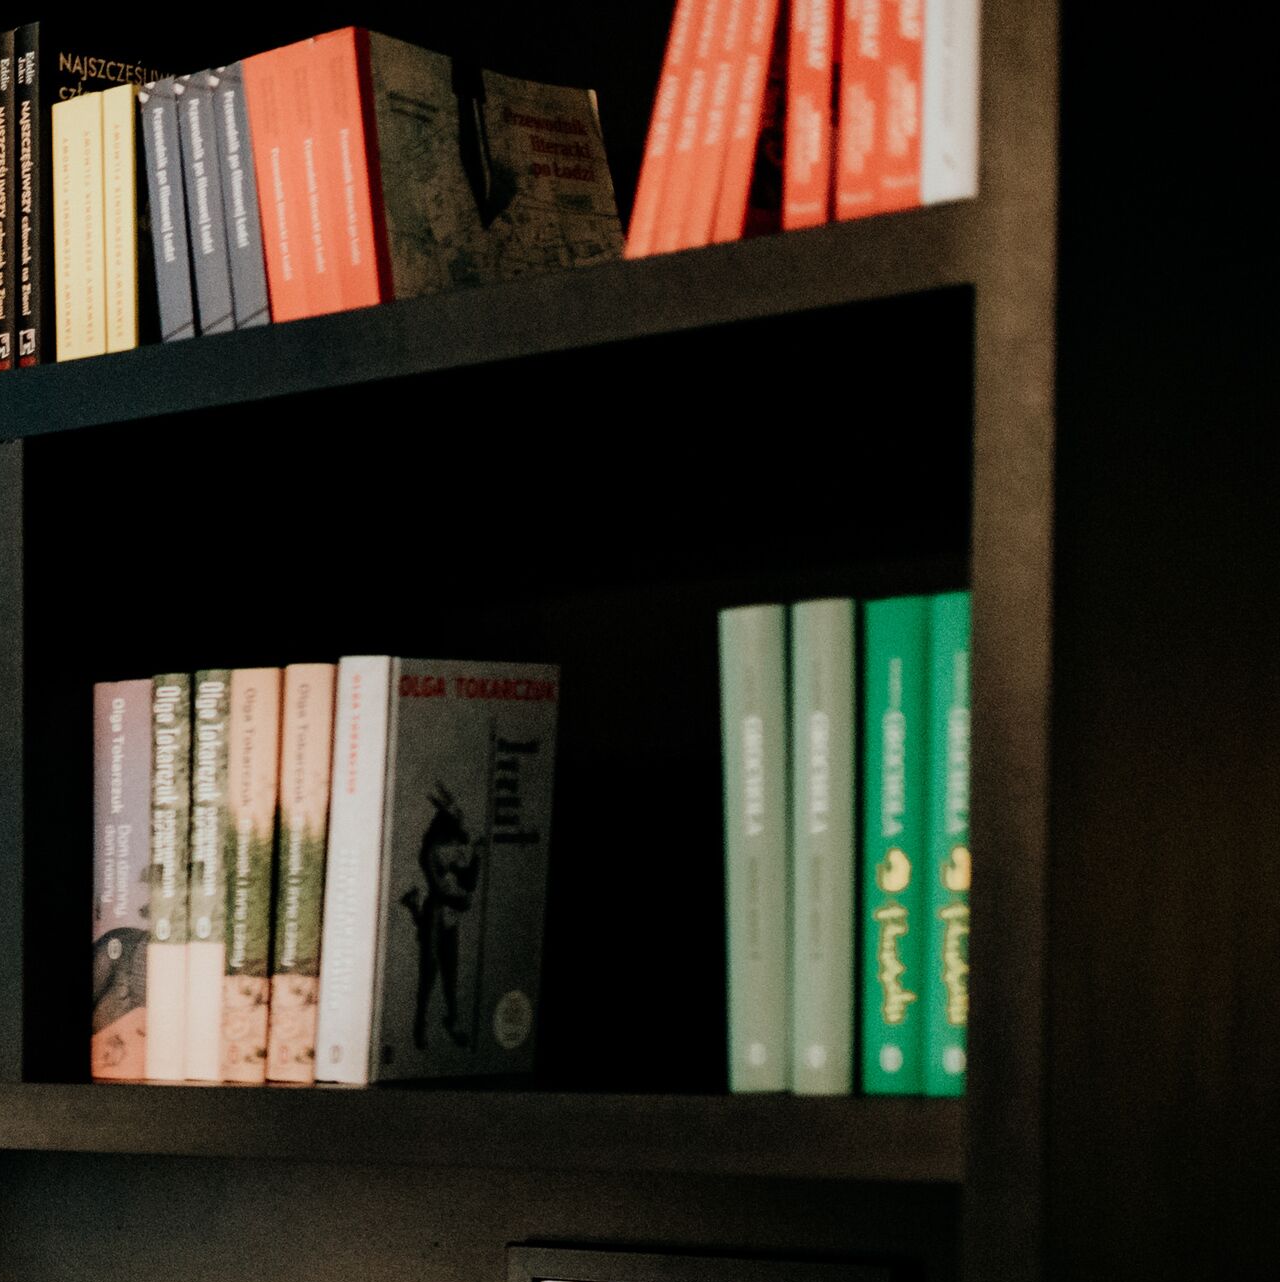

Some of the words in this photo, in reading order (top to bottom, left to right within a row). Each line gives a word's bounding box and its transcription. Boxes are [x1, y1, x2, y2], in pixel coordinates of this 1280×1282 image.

[154, 685, 181, 723] Olga
[196, 681, 225, 720] Olga
[399, 675, 445, 699] OLGA
[454, 677, 558, 702] TOKARCZUK
